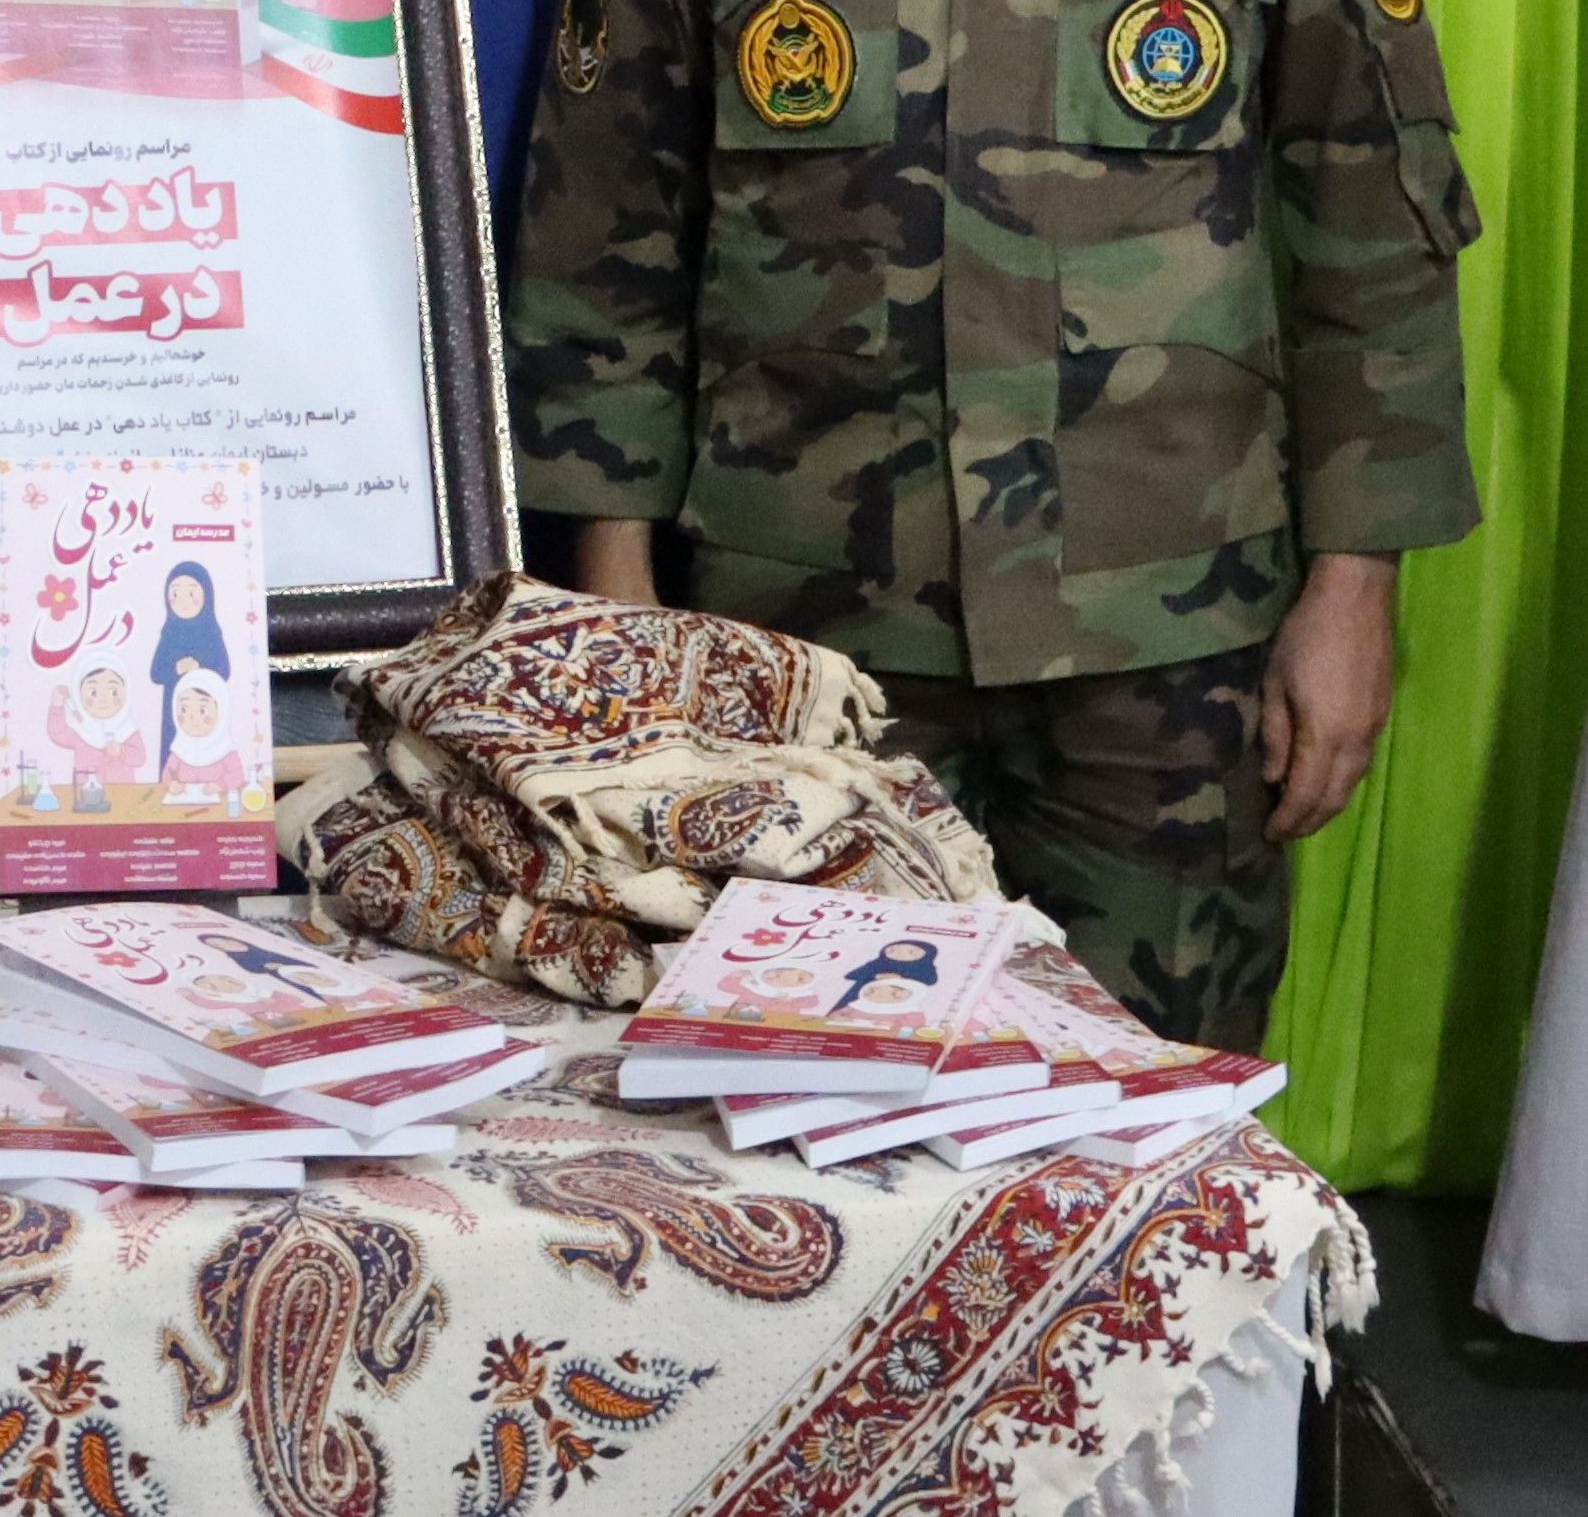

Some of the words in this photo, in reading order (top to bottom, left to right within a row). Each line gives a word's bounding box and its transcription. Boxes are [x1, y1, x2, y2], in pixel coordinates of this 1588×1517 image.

[5, 142, 48, 165] کتاب
[48, 141, 63, 163] از
[65, 140, 133, 164] رونمایی
[136, 138, 192, 161] مراسم
[3, 261, 145, 345] عمل
[147, 265, 223, 340] در
[48, 416, 80, 437] عمل
[85, 417, 103, 436] در
[225, 410, 240, 429] از
[244, 410, 301, 430] رونمایی
[305, 407, 358, 427] مراسم
[353, 475, 396, 497] حضور
